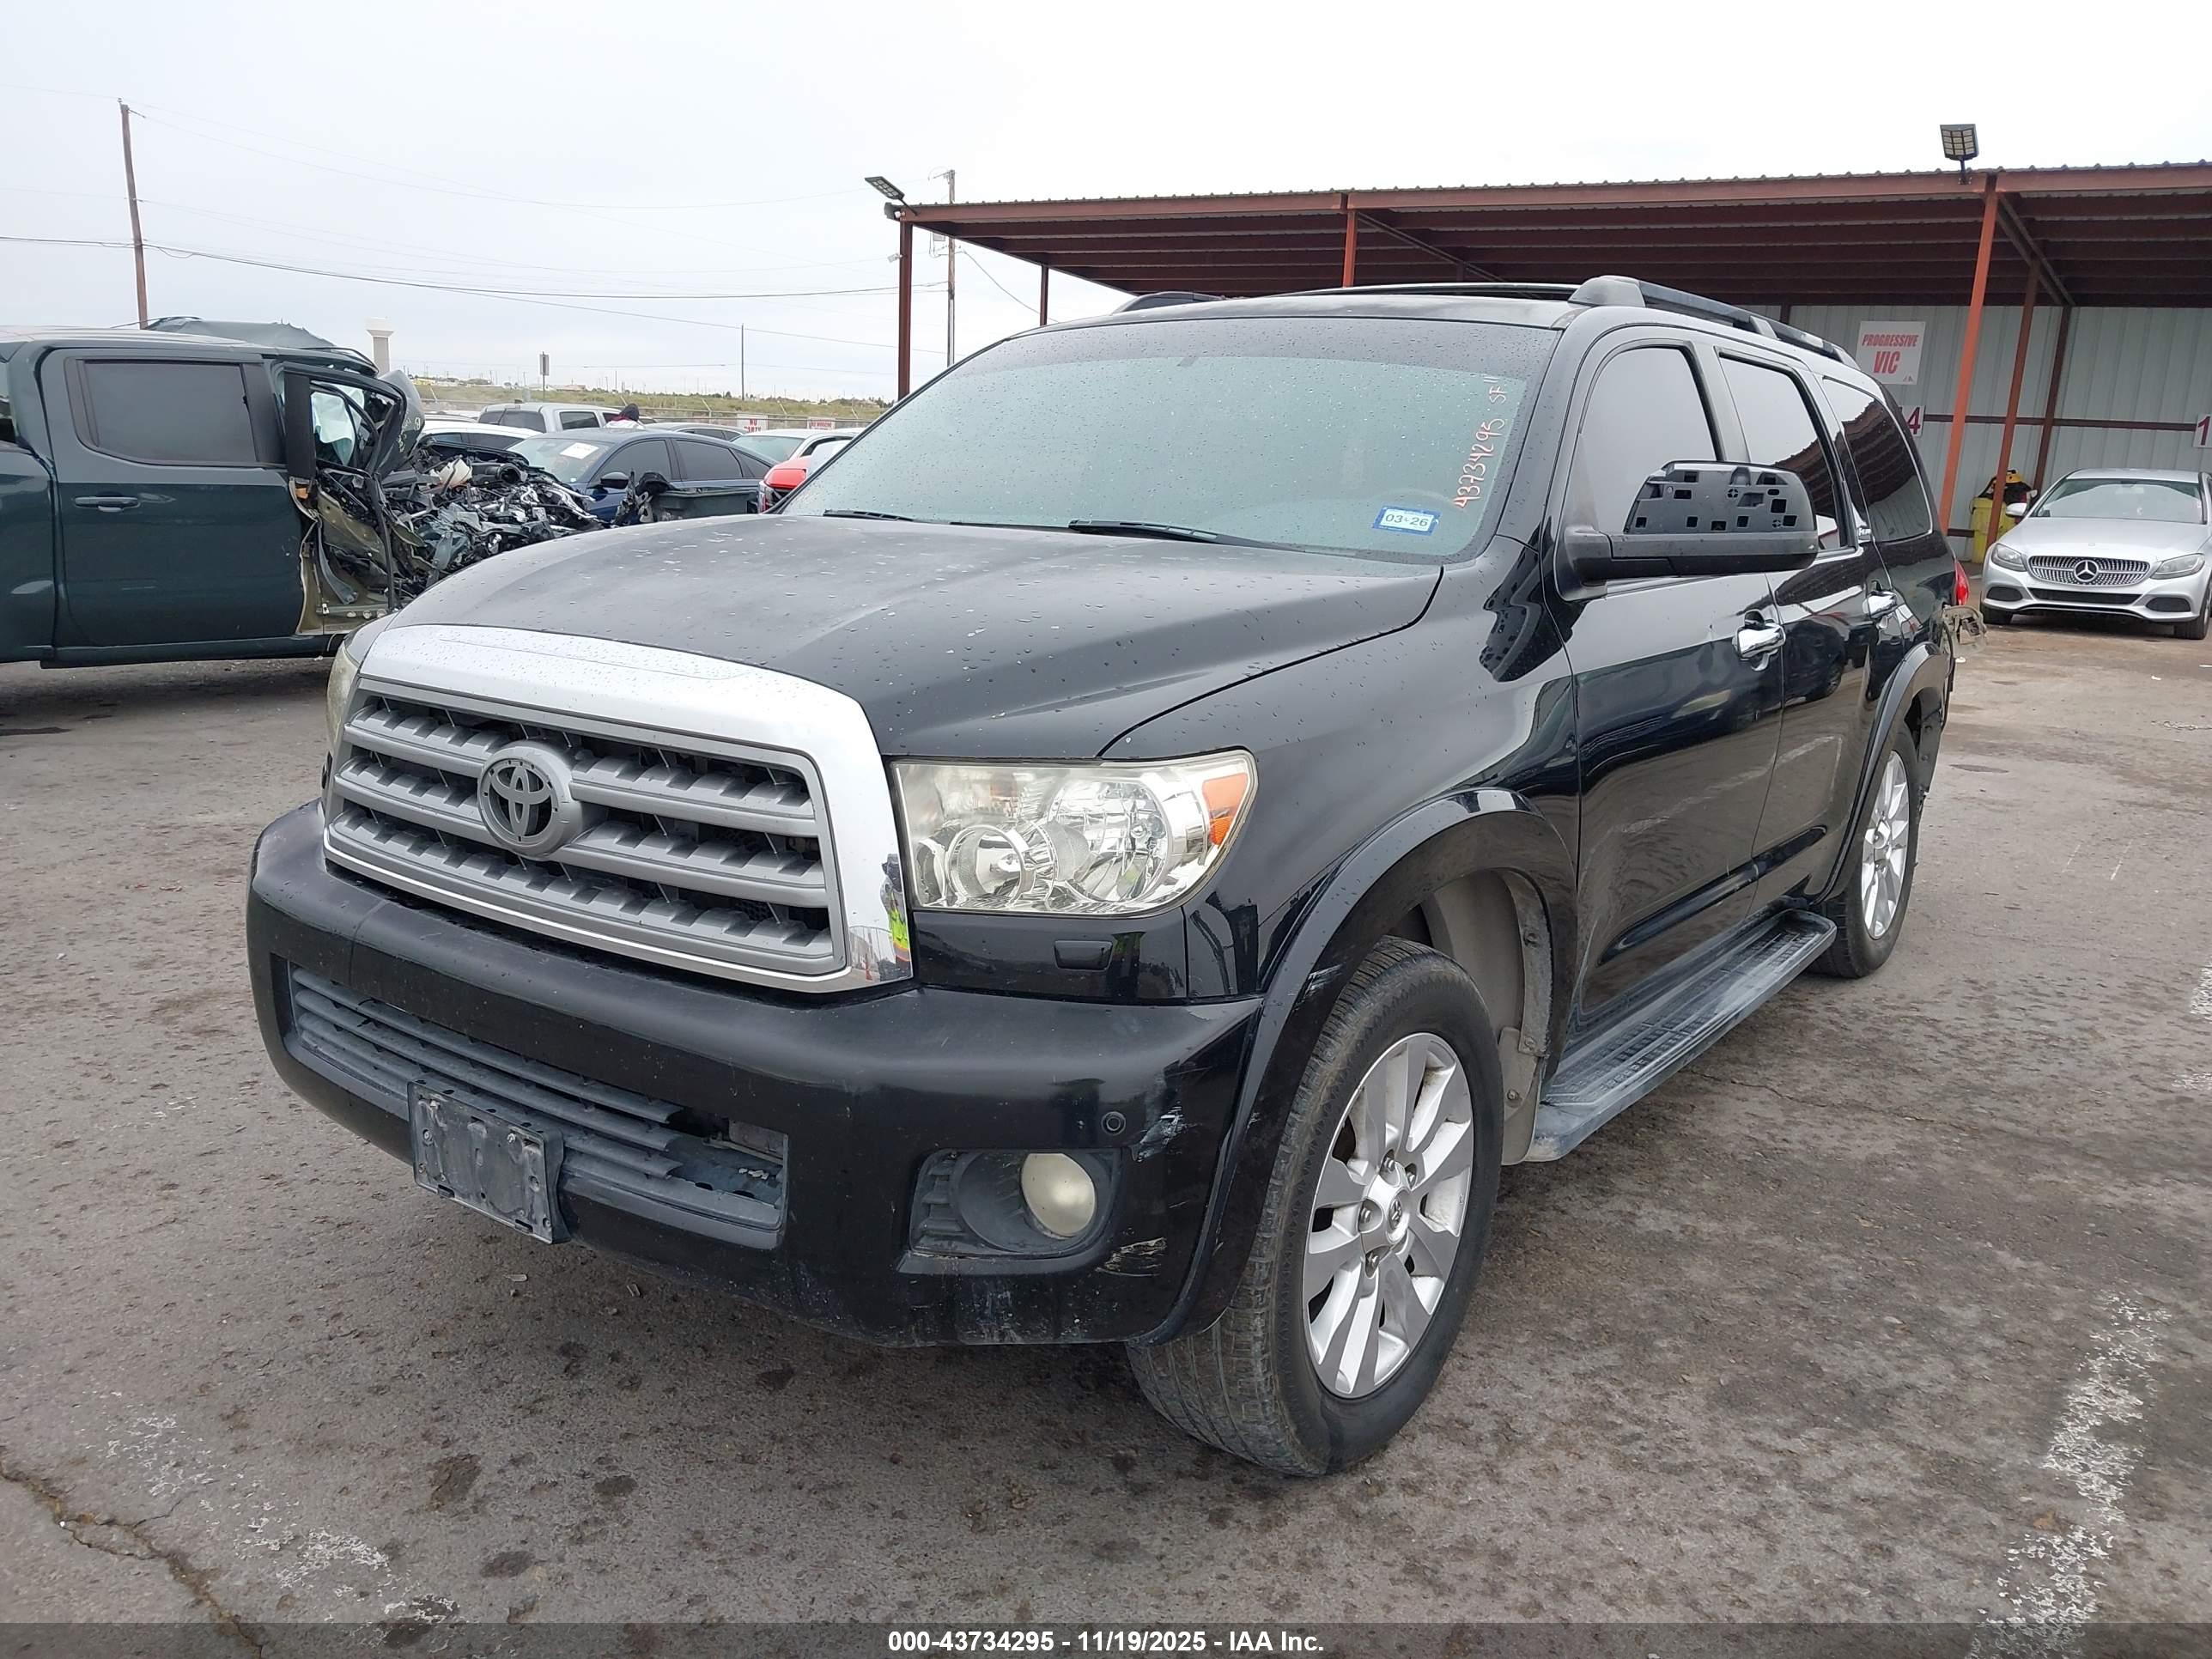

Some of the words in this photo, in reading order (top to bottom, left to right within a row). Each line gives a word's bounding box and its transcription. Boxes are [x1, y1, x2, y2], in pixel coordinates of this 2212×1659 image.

[1861, 333, 1919, 347] PROGRESSIVE
[1873, 350, 1901, 374] VIC
[1452, 418, 1505, 508] 43734295
